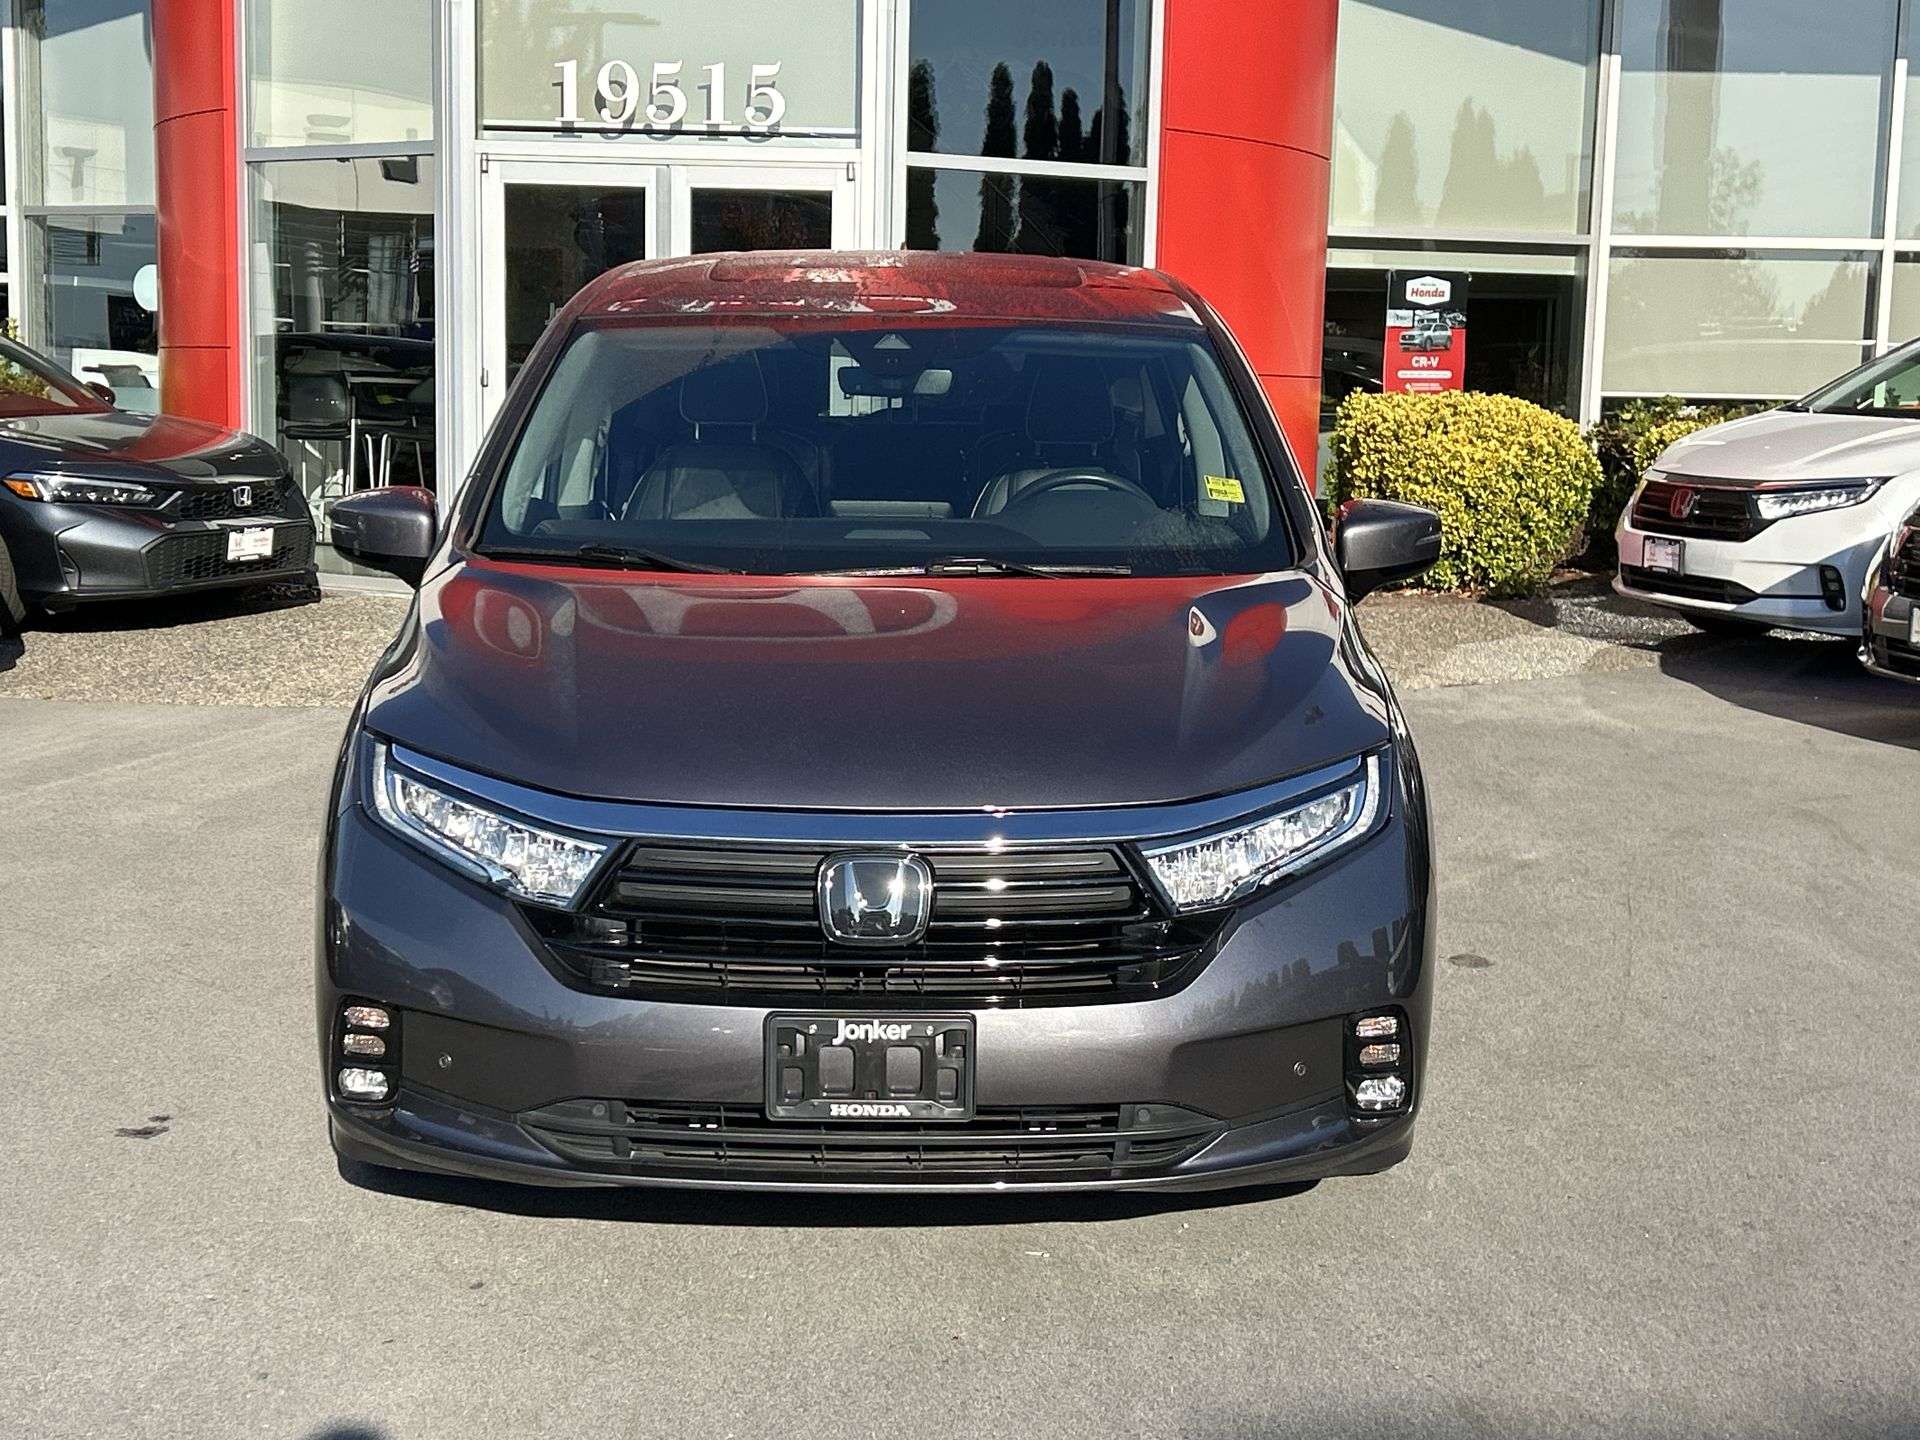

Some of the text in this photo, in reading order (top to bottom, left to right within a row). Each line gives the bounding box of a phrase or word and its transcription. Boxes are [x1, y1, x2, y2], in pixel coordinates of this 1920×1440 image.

[553, 59, 786, 126] 19515
[1410, 287, 1446, 298] Honda
[1411, 355, 1440, 368] CR-V
[832, 1019, 912, 1045] Jonker
[829, 1103, 912, 1117] HONDA
